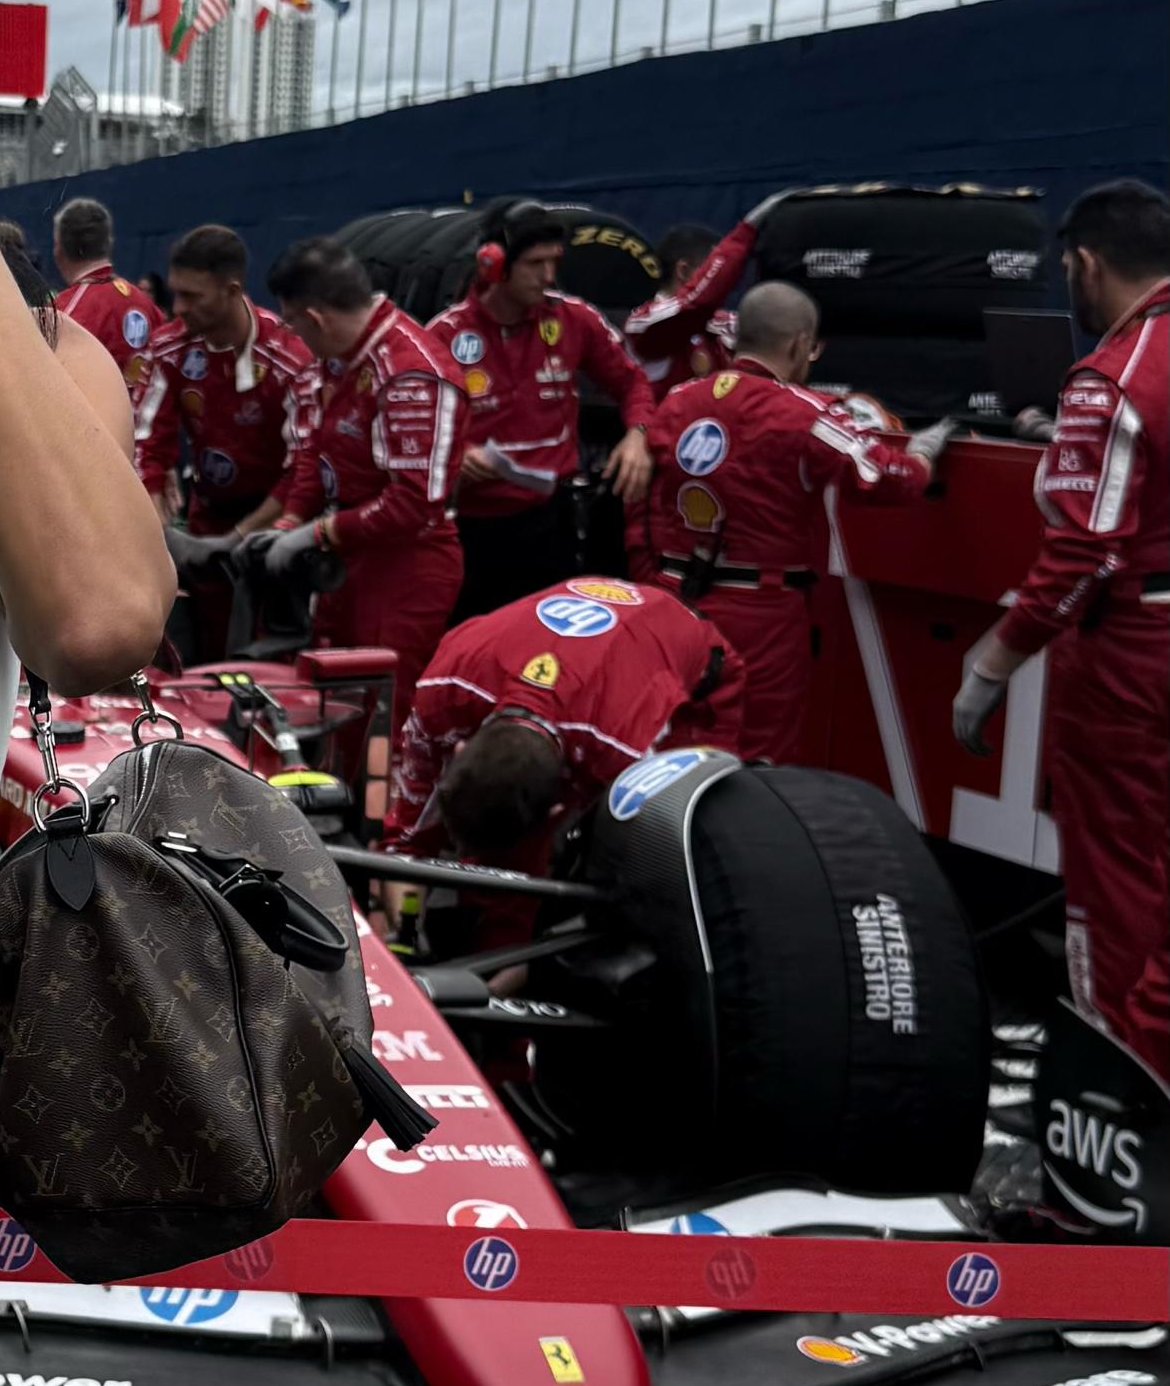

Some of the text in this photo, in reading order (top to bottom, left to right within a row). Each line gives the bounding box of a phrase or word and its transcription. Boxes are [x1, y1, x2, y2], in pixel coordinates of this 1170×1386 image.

[571, 224, 661, 280] ZERO
[457, 332, 480, 362] hp
[681, 423, 722, 471] hp
[852, 905, 890, 1020] SINISTRO
[876, 893, 918, 1034] ANTERIORE
[416, 1144, 528, 1163] CELSIUS
[1046, 1098, 1143, 1190] aws
[472, 1238, 512, 1290] hp
[954, 1254, 994, 1306] hp
